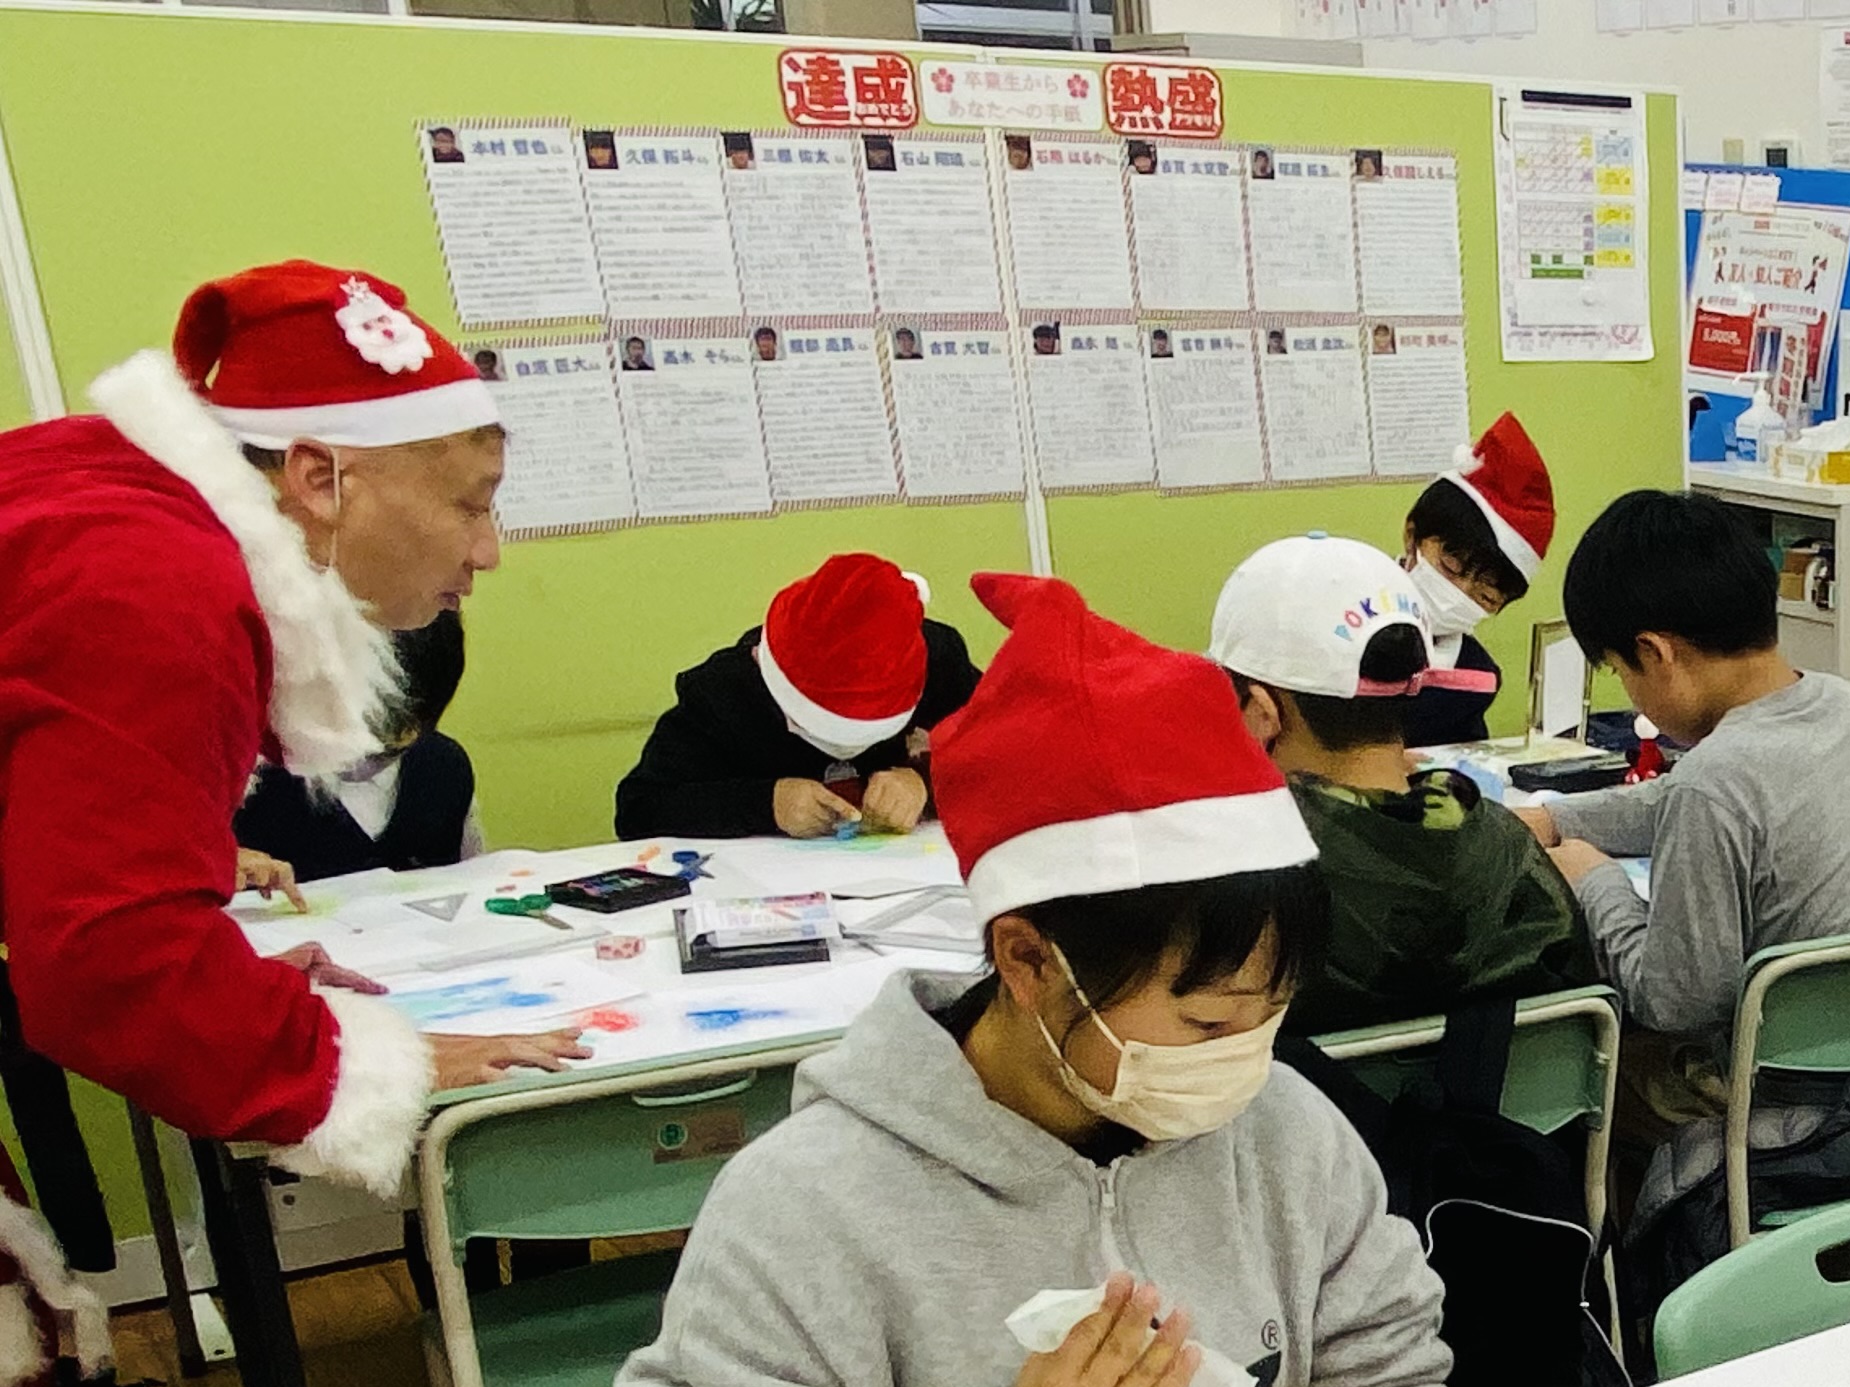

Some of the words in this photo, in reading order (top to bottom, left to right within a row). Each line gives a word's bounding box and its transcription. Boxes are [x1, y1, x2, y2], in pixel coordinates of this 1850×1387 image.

[786, 54, 909, 121] 達成
[947, 99, 1082, 123] あなたへの手紙
[1111, 68, 1217, 131] 熱盛
